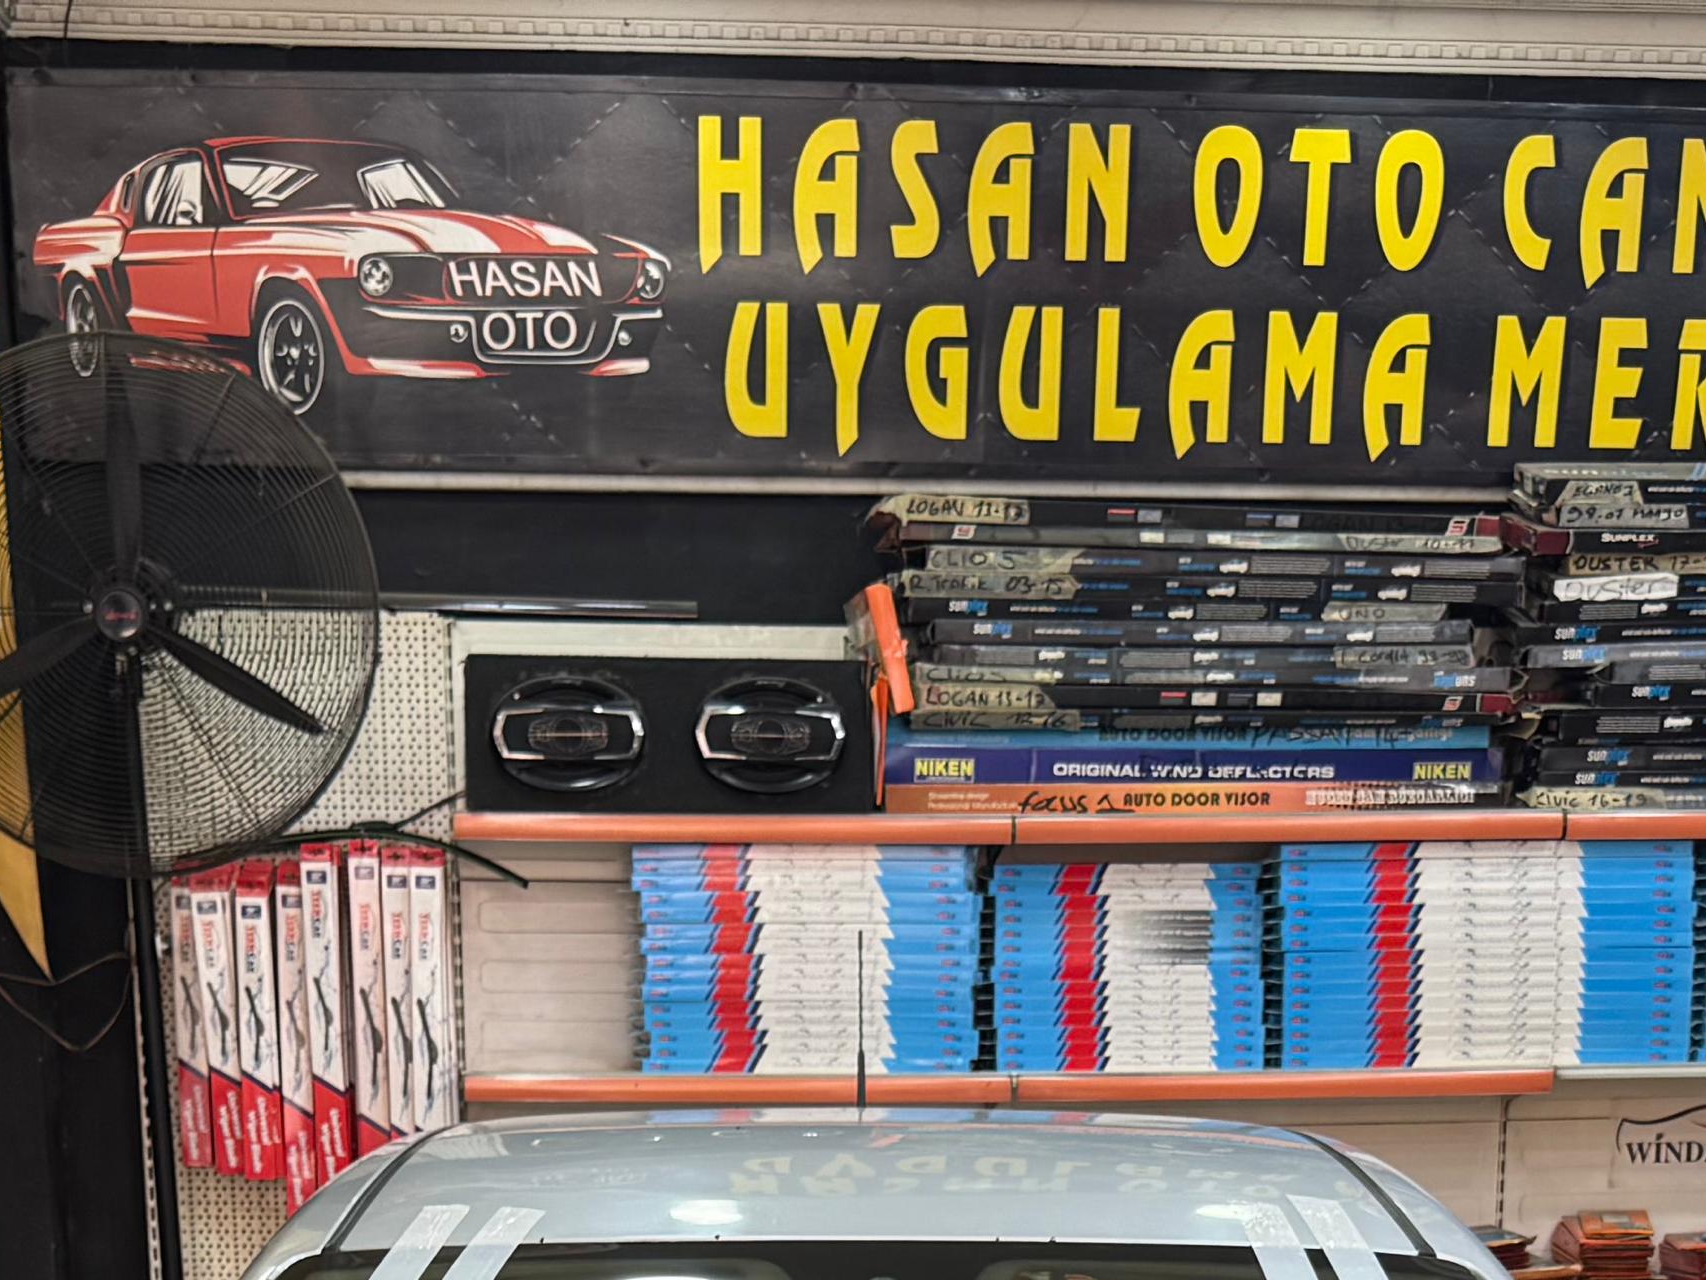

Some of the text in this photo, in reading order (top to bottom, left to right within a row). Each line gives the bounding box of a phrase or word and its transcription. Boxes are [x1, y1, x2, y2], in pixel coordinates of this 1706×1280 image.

[699, 116, 1132, 277] HASAN
[1194, 125, 1445, 272] OTO
[449, 259, 602, 298] HASAN
[483, 311, 580, 351] OTO
[726, 302, 1433, 462] UYGULAMA
[915, 760, 974, 777] NIKEN
[1053, 762, 1142, 778] ORIGINAL
[1414, 763, 1472, 780] NIKEN
[1124, 791, 1271, 807] AUTO DOOR VISOR
